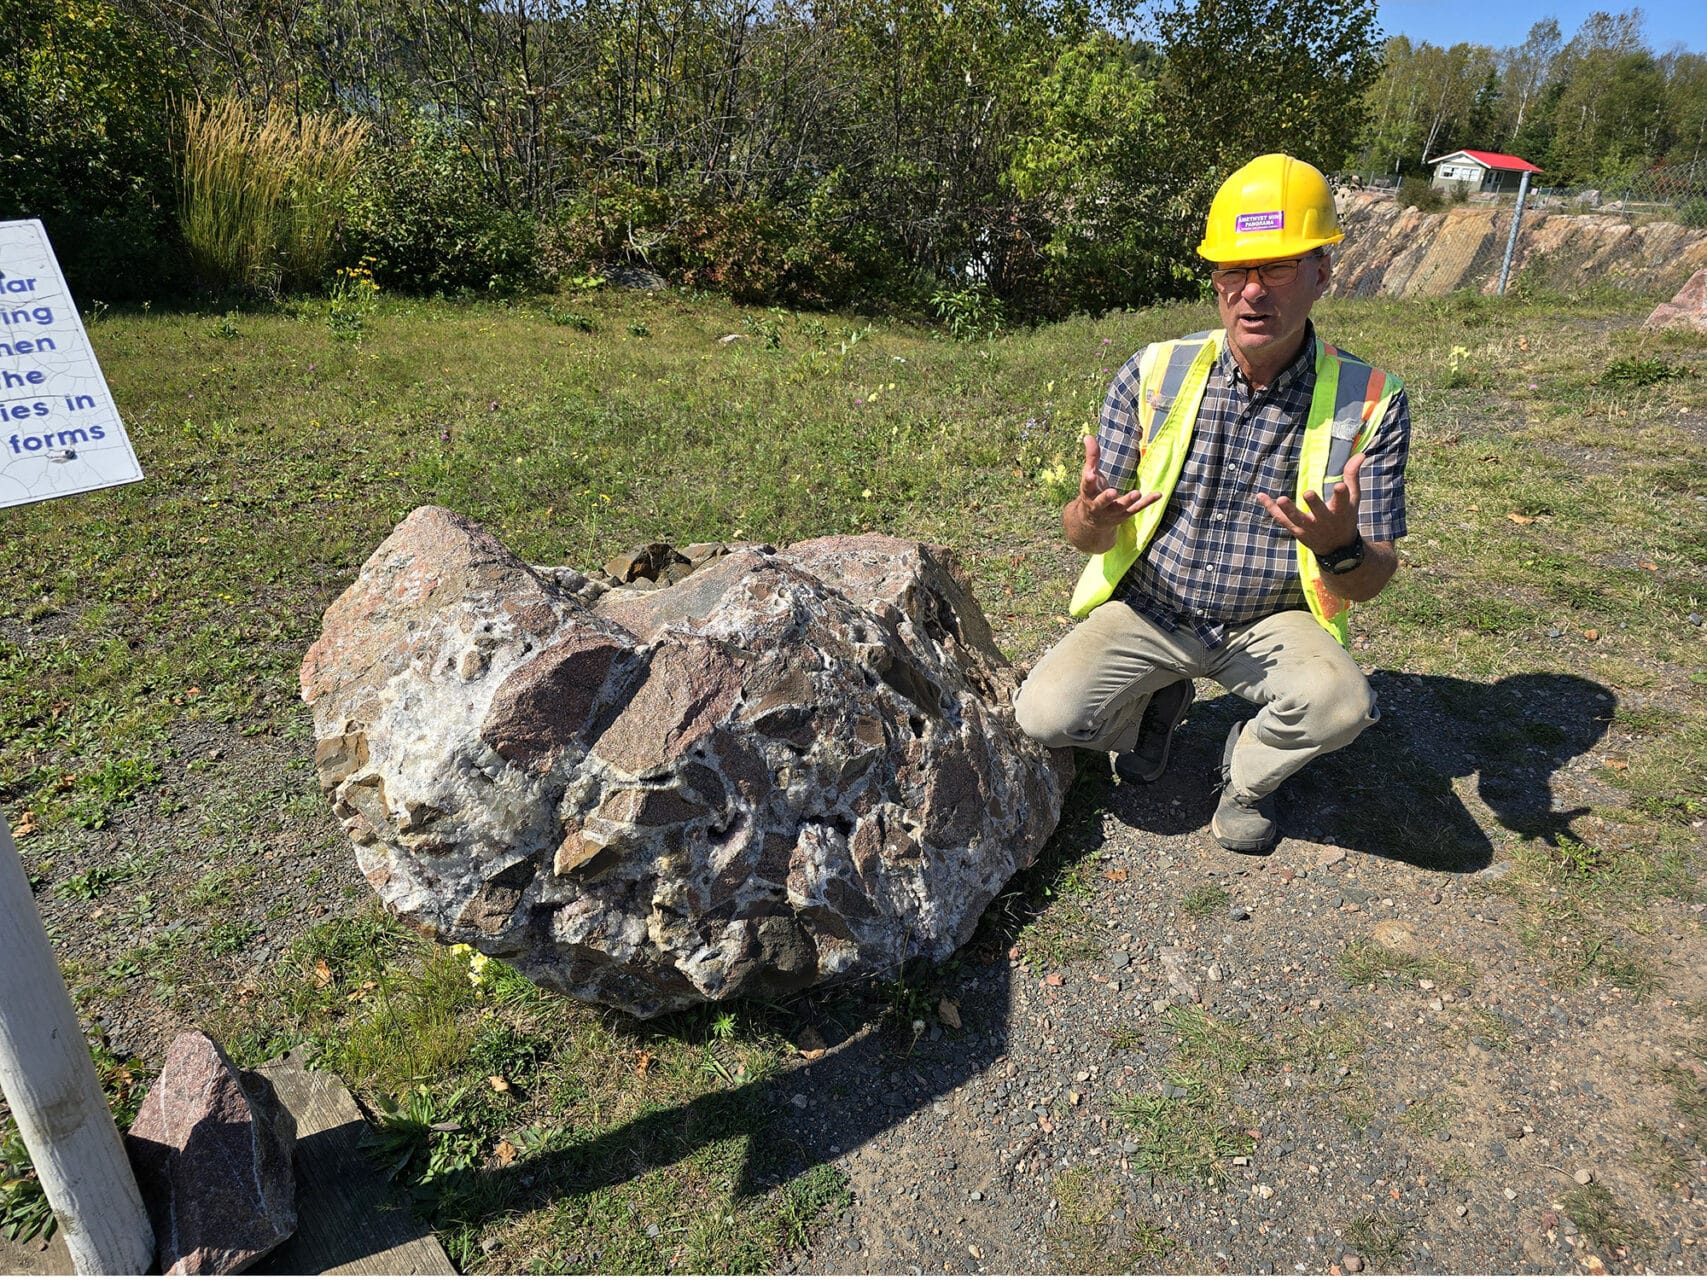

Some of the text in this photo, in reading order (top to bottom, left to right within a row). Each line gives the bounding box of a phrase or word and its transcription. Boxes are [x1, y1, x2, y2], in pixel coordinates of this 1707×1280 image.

[1245, 220, 1274, 228] PANORAMA
[65, 393, 96, 412] in
[9, 424, 106, 454] forms
